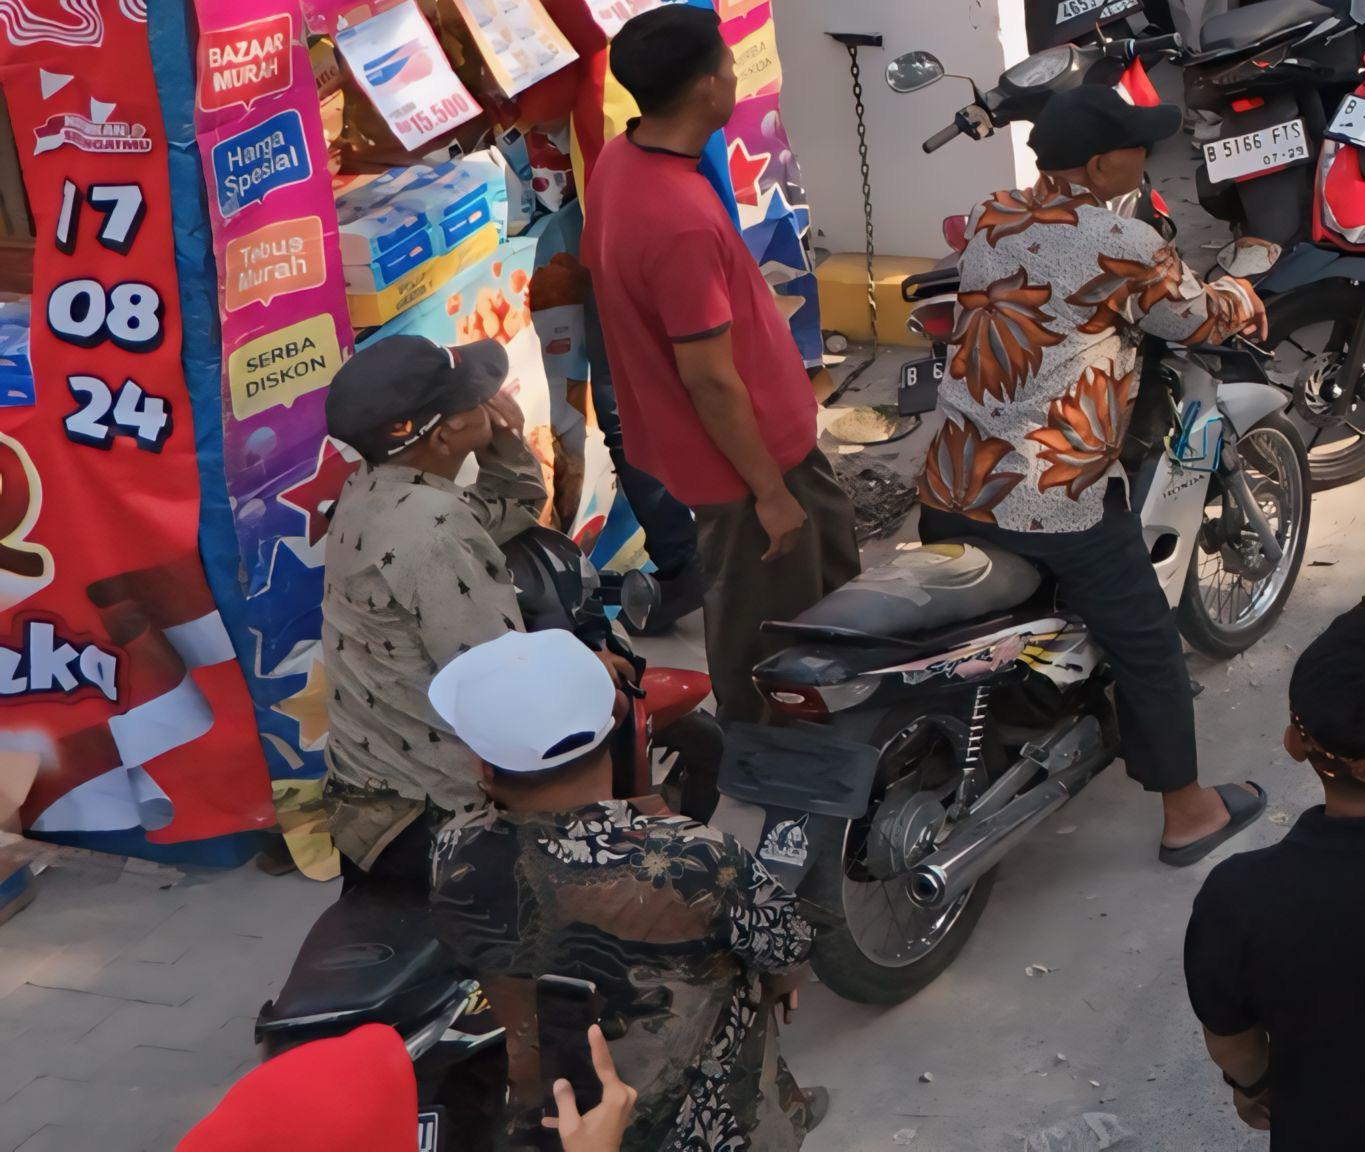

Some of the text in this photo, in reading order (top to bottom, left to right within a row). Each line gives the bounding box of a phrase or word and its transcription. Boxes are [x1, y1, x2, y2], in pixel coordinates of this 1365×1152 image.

[207, 32, 285, 68] BAZAAR
[212, 57, 279, 93] MURAH
[1345, 98, 1358, 115] B
[226, 130, 286, 172] Harga
[1207, 122, 1302, 163] B 5166 FTS
[223, 145, 299, 198] Spesial
[56, 179, 145, 247] 17
[239, 236, 305, 268] Tebus
[237, 255, 308, 293] Murah
[48, 279, 161, 344] 08
[246, 336, 317, 374] SERBA
[245, 354, 328, 399] DISKON
[907, 367, 918, 386] B
[65, 374, 168, 444] 24
